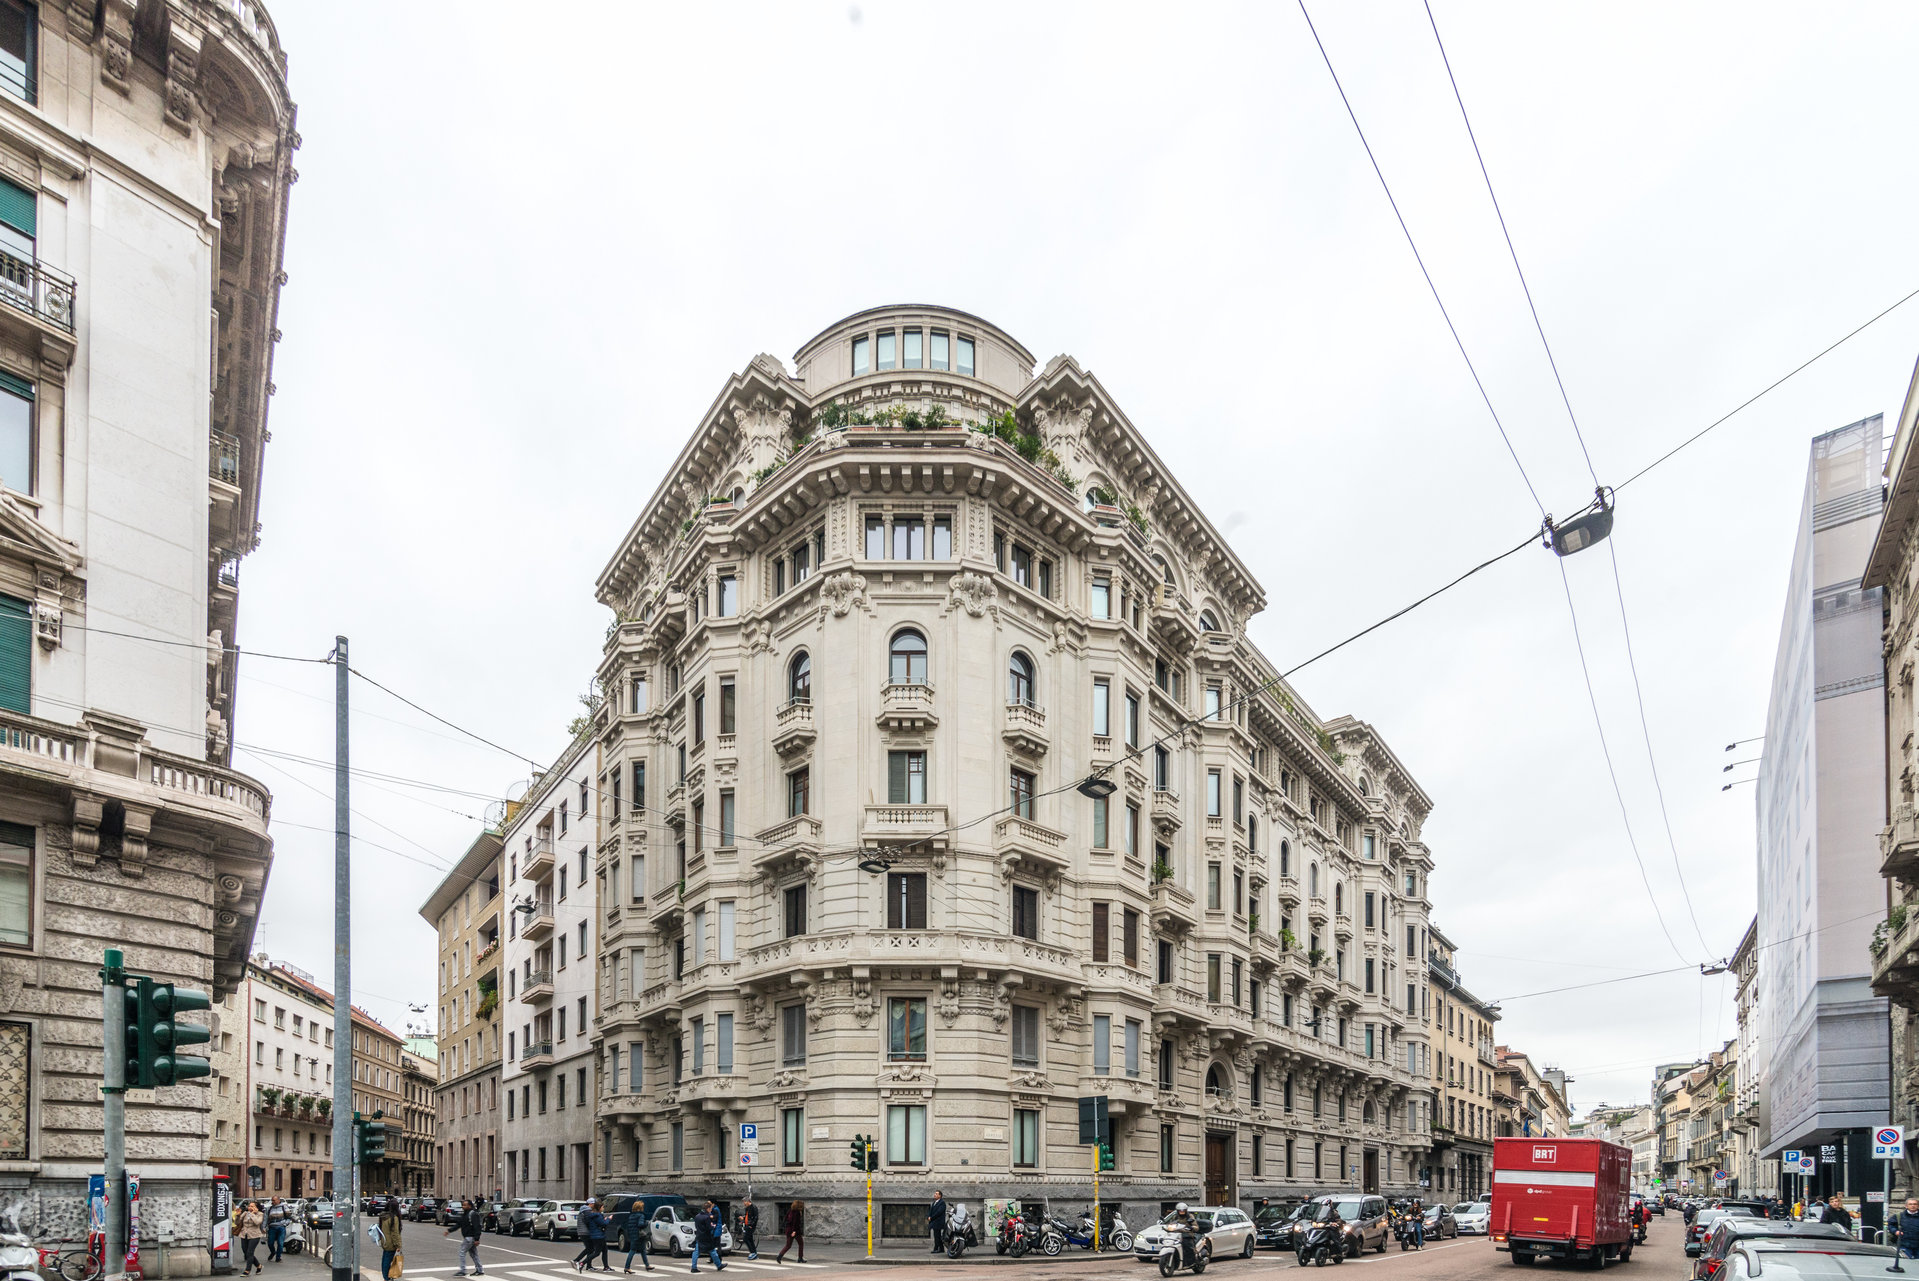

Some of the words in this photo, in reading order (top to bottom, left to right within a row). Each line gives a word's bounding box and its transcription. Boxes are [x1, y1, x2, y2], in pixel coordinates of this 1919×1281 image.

[745, 1126, 754, 1138] P
[1534, 1149, 1554, 1159] BRT
[1788, 1152, 1797, 1161] P
